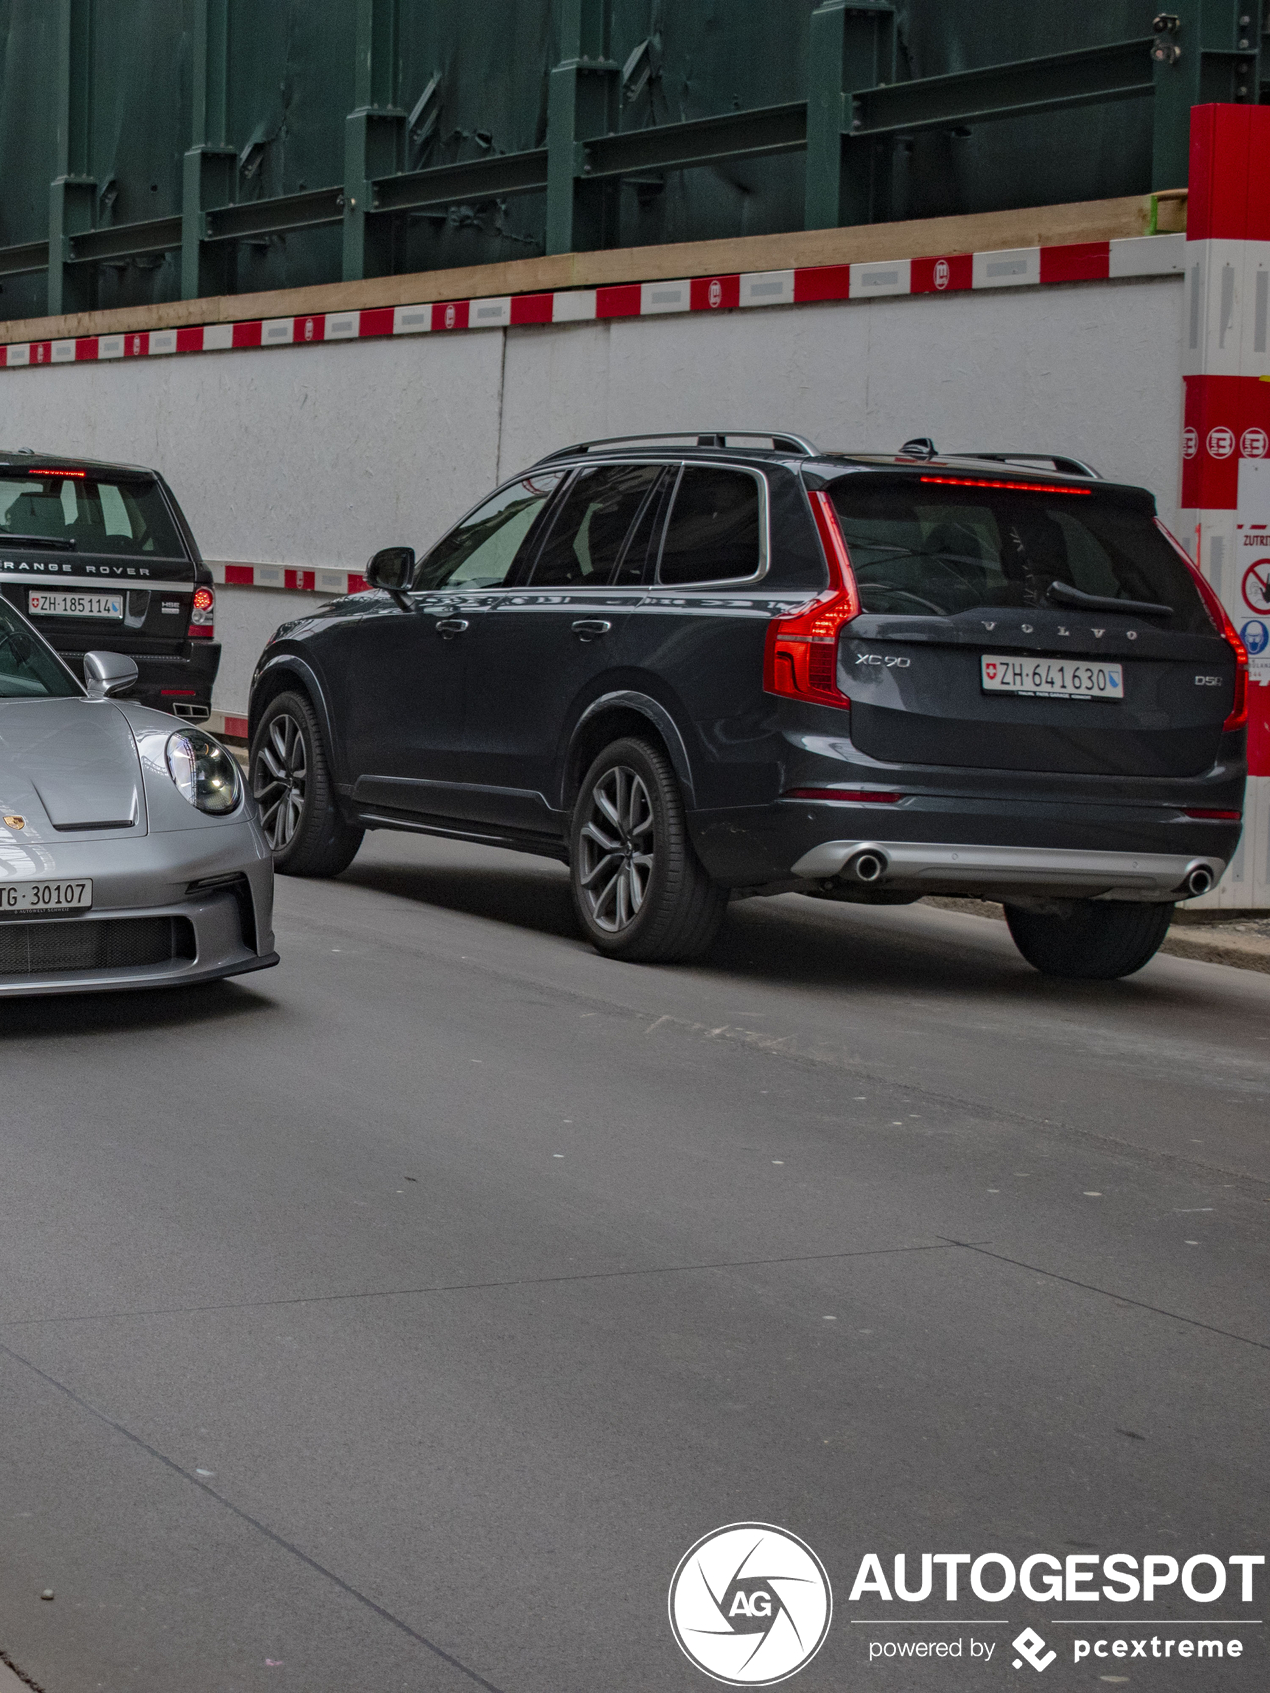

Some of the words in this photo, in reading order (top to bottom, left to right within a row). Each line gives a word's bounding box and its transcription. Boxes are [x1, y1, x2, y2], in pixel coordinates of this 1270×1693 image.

[3, 561, 72, 572] RANGE
[86, 565, 150, 576] ROVER
[981, 620, 1138, 641] VOLVO
[855, 653, 910, 668] XC90
